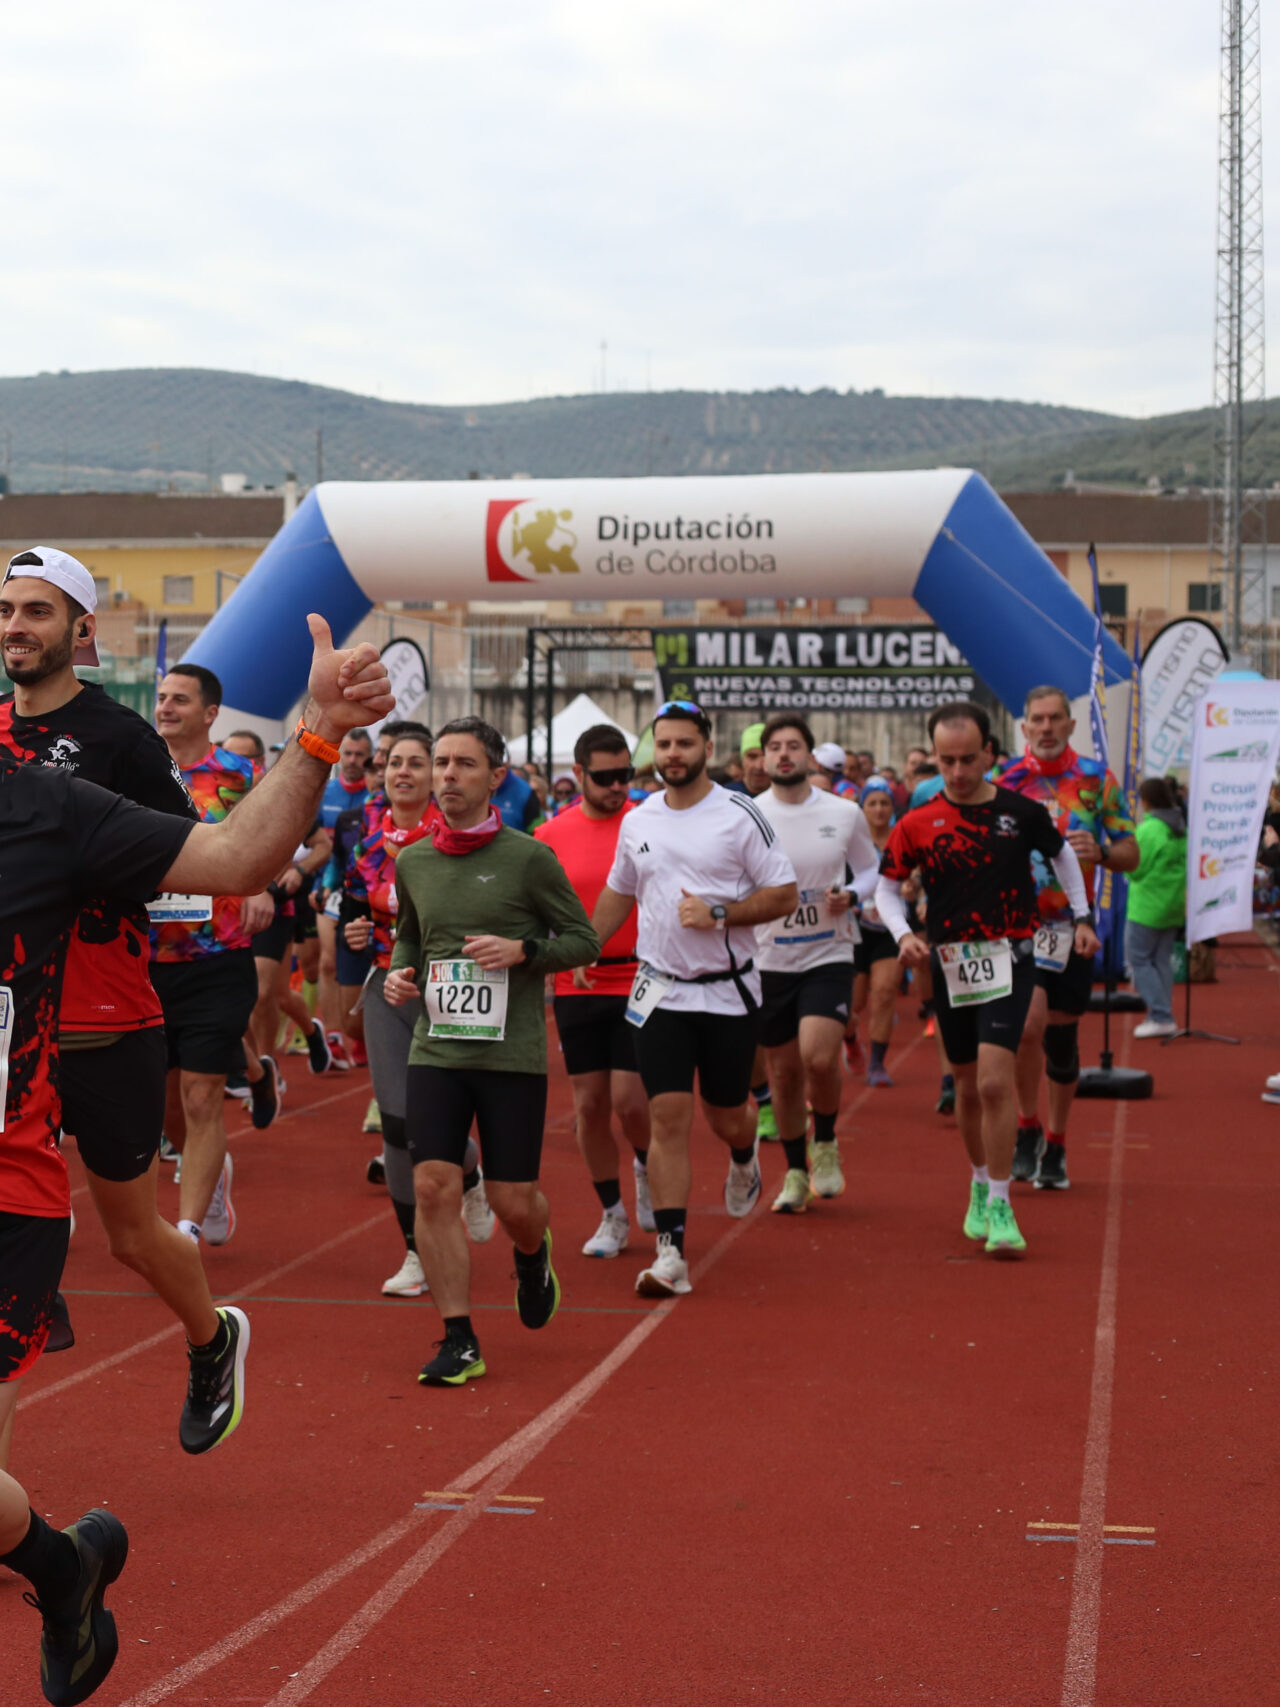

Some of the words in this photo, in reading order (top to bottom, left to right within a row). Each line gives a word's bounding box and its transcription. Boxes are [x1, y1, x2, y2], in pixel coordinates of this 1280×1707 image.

[597, 513, 775, 546] Diputación
[596, 550, 635, 575] de
[646, 549, 778, 575] Córdoba
[695, 632, 823, 666] MILAR
[836, 632, 968, 666] LUCEN
[694, 676, 792, 692] NUEVAS
[799, 673, 974, 692] TECNOLOGÍAS
[783, 905, 818, 929] 240
[958, 957, 995, 984] 429
[435, 984, 492, 1014] 1220
